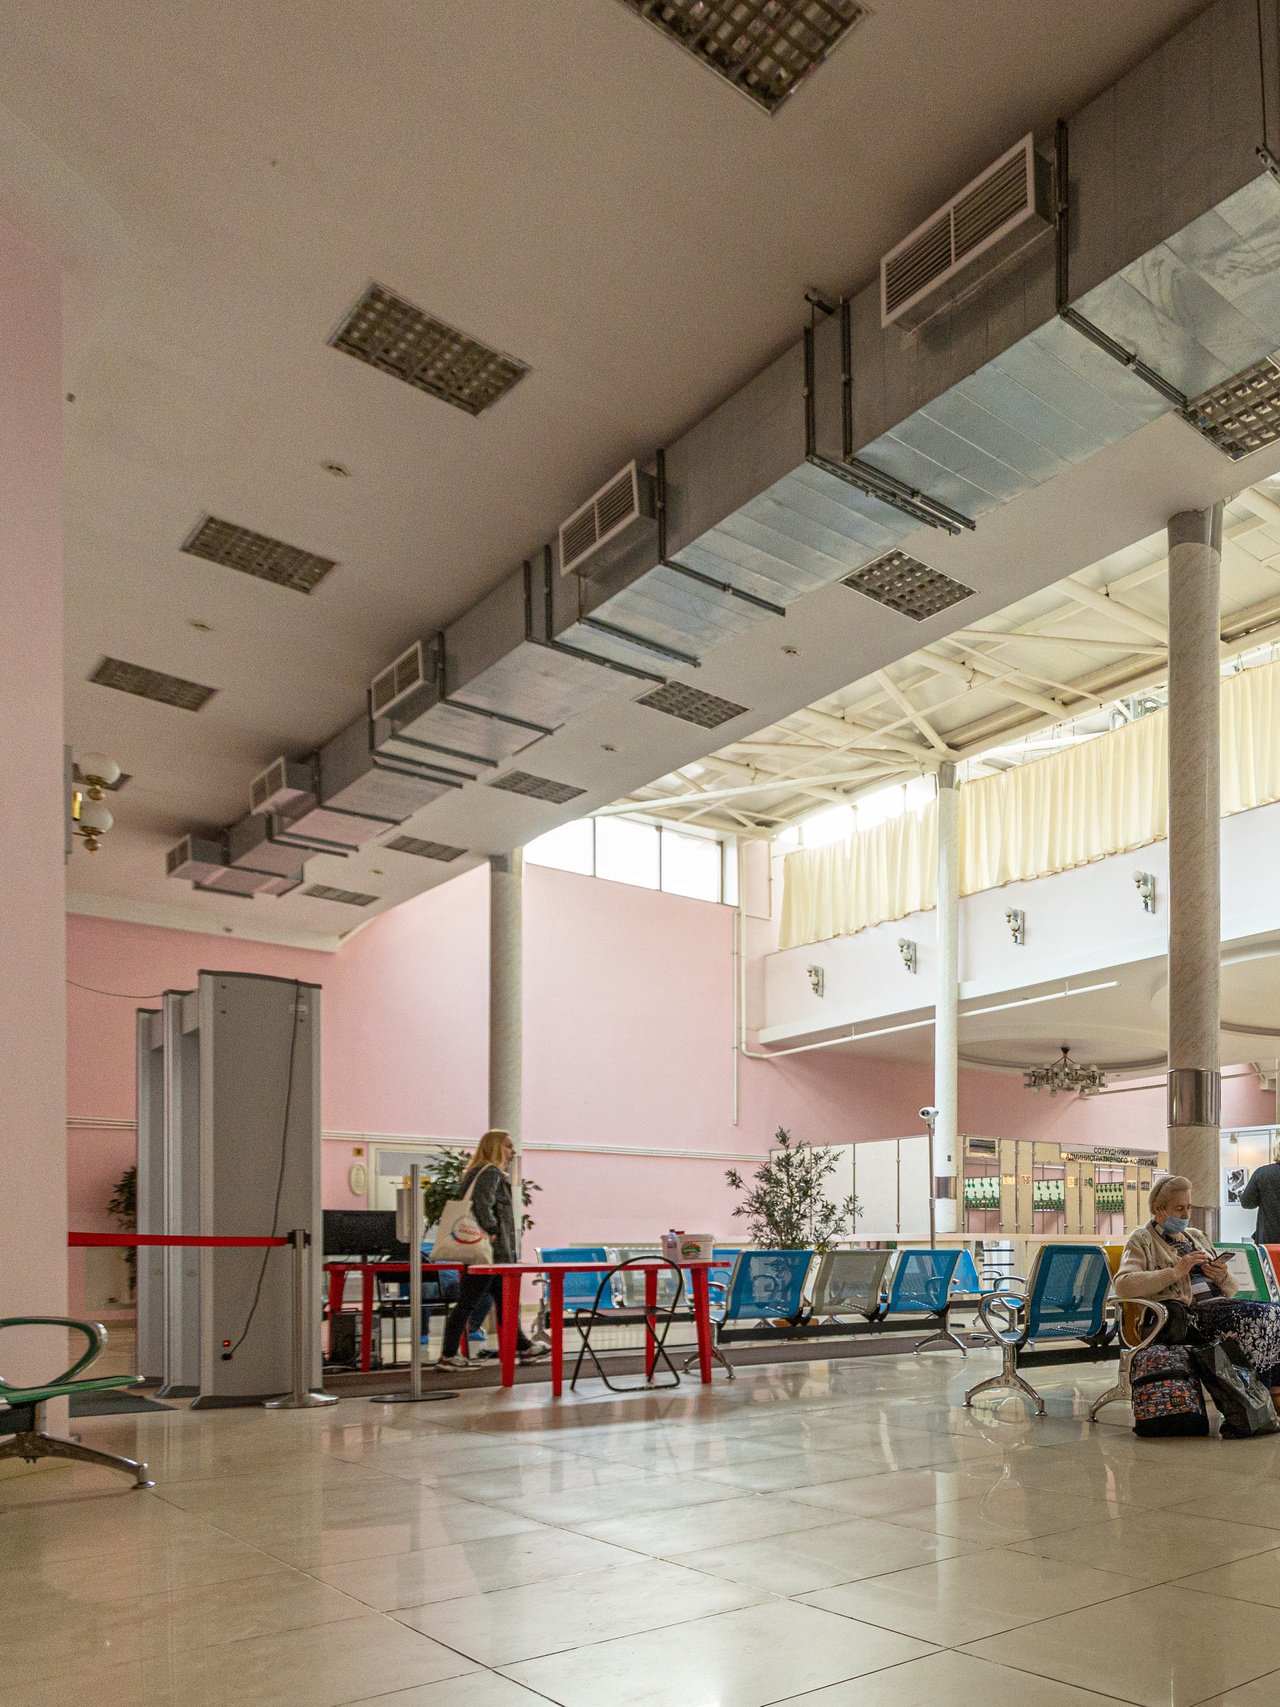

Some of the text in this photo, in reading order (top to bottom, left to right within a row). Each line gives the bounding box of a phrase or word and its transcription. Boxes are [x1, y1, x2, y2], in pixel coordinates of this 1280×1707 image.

[1093, 1147, 1130, 1156] СОТРУДНИКИ
[1065, 1153, 1155, 1166] АДМИНИСТРАТИВНОГО КОРПУСА
